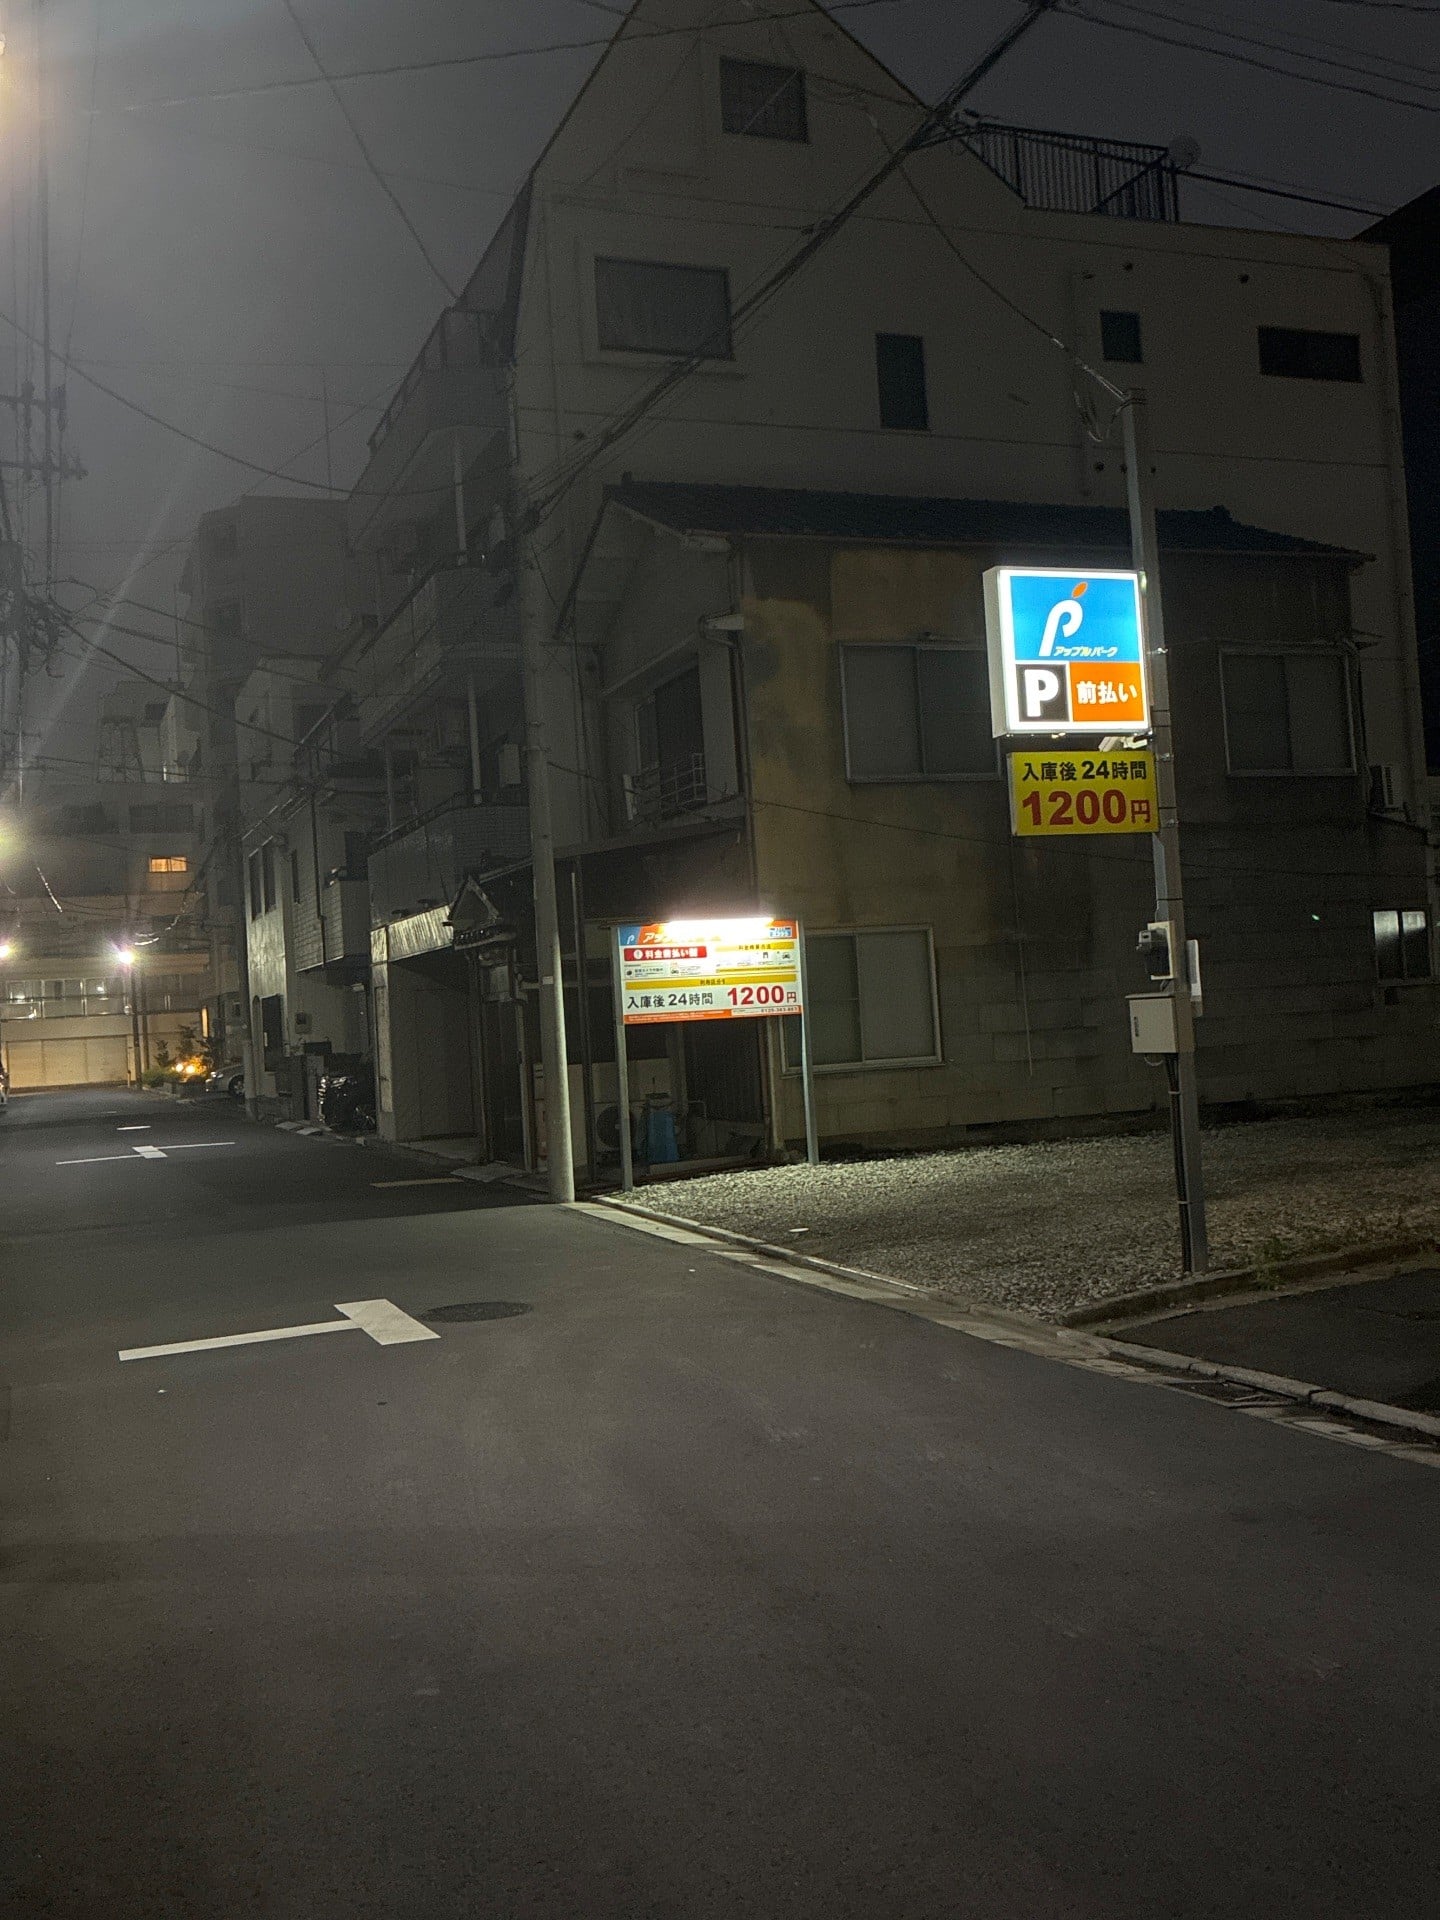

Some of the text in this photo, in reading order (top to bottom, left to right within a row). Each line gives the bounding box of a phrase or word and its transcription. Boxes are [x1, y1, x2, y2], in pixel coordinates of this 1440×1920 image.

[1053, 645, 1119, 658] アップルパーク
[1024, 668, 1060, 718] P
[1076, 681, 1138, 705] 前払い
[1022, 789, 1152, 826] 1200円
[727, 985, 798, 1006] 1200円
